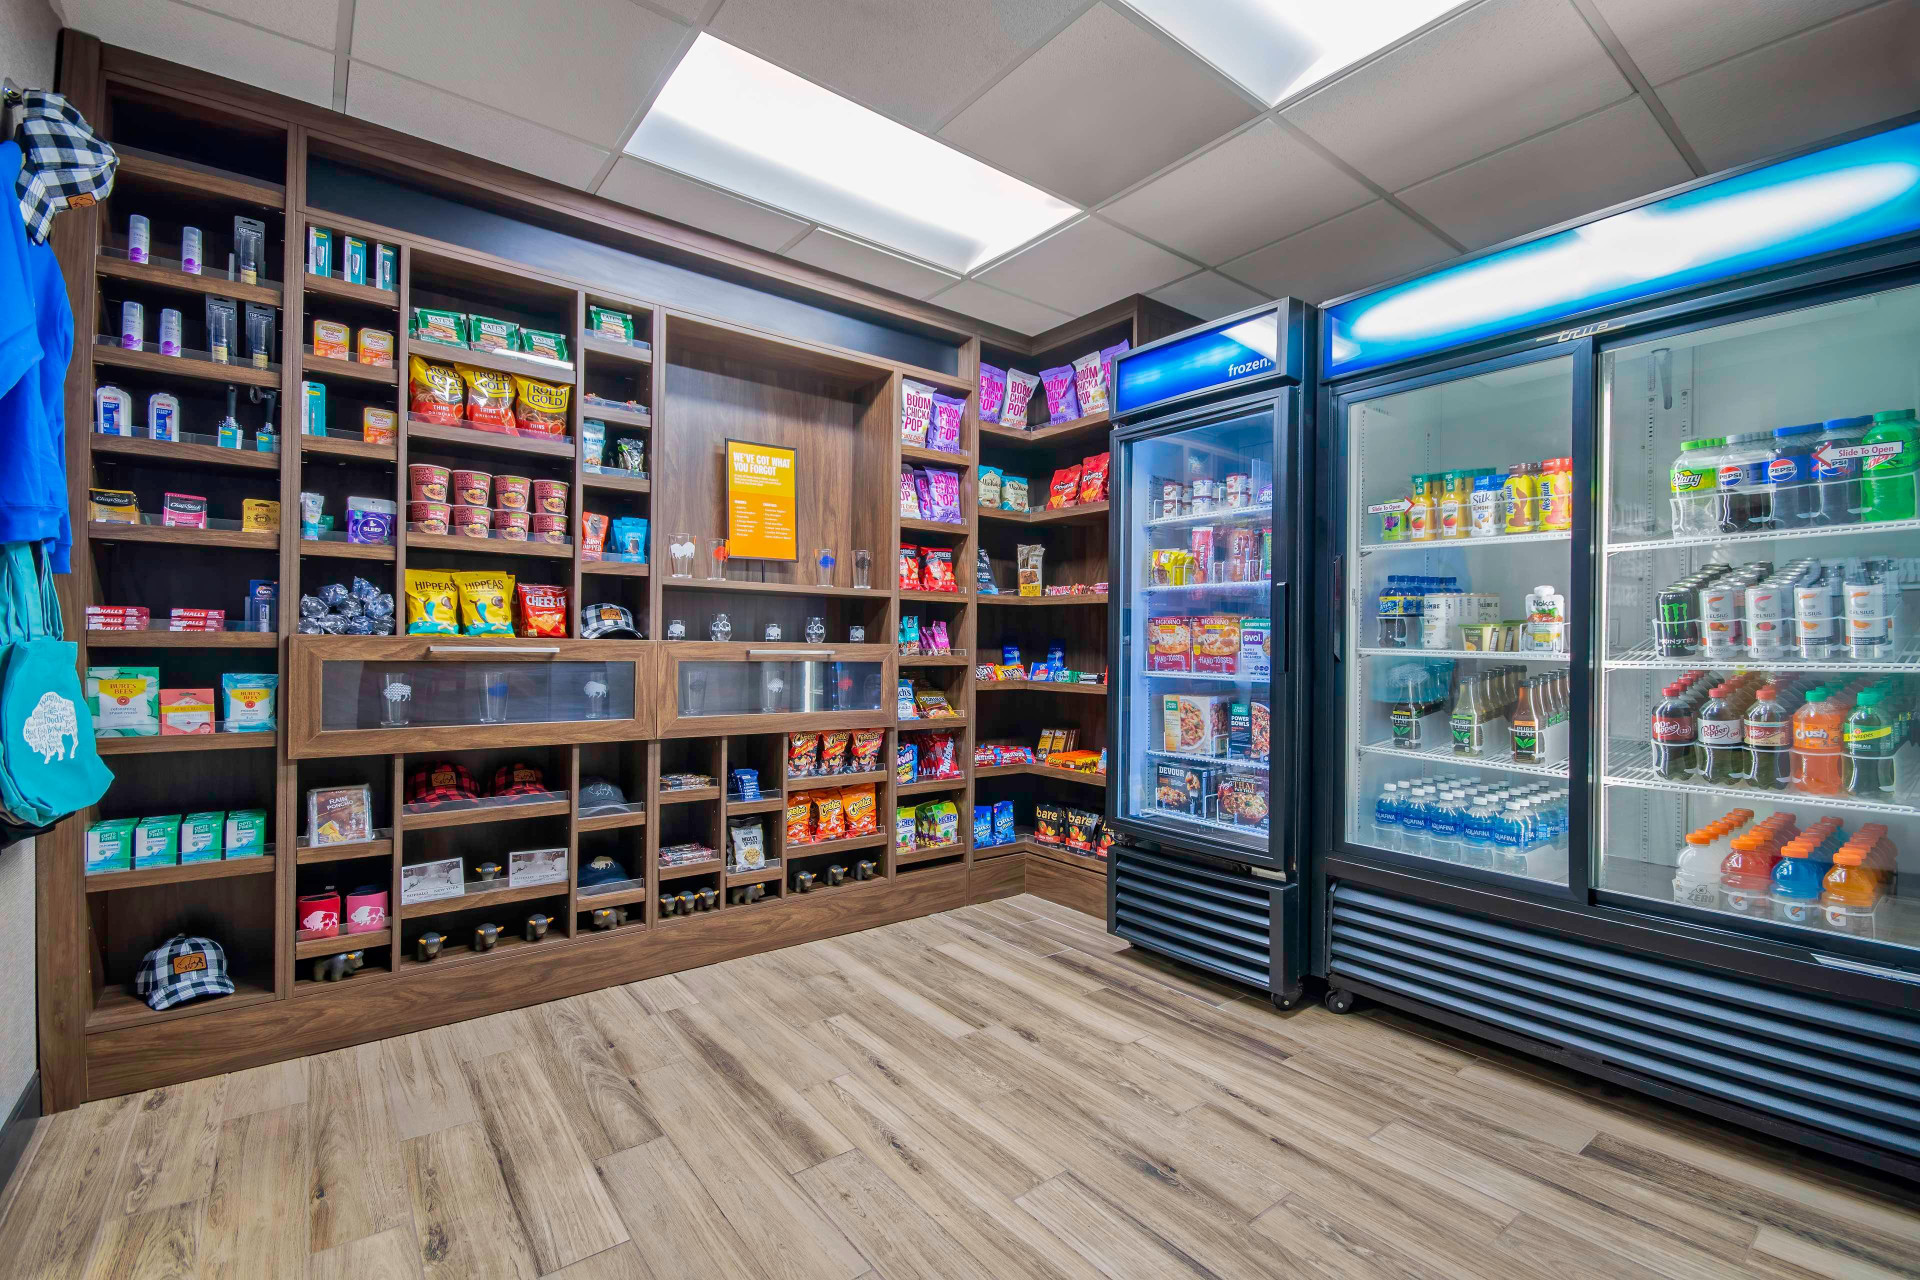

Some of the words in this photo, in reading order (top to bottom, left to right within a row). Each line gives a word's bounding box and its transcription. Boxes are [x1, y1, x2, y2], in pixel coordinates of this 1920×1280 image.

[1228, 357, 1272, 377] frozen.
[479, 371, 508, 382] ROLD
[532, 385, 562, 397] ROLD
[532, 394, 562, 406] GOLD
[907, 393, 931, 410] BOOM
[904, 416, 923, 432] POP
[1838, 447, 1859, 457] Slide
[1860, 446, 1870, 455] To
[1871, 445, 1894, 456] Open
[733, 452, 755, 464] WE'VE
[757, 455, 770, 466] GOT
[771, 457, 791, 468] WHAT
[734, 462, 749, 472] YOU
[750, 464, 777, 476] FORGOT
[1769, 465, 1797, 474] PEPSI
[1672, 471, 1702, 486] Starry
[1719, 472, 1743, 480] PEPSI
[96, 496, 128, 504] ChapStick
[1472, 493, 1490, 503] Silk
[1541, 482, 1552, 511] Nesquik
[170, 502, 201, 511] ChapStick
[415, 581, 457, 592] HIPPEAS
[465, 579, 504, 590] HIPPEAS
[1654, 722, 1677, 734] Pepper
[1703, 725, 1727, 737] Pepper
[1795, 729, 1828, 740] Crush
[1159, 765, 1184, 776] DEVOUR
[326, 800, 353, 810] PONCHO
[329, 796, 348, 804] RAIN
[821, 800, 841, 817] Cheetos
[849, 797, 872, 816] Cheetos
[1036, 806, 1058, 821] bare
[1068, 811, 1093, 826] bare
[1465, 828, 1490, 838] AQUAFINA
